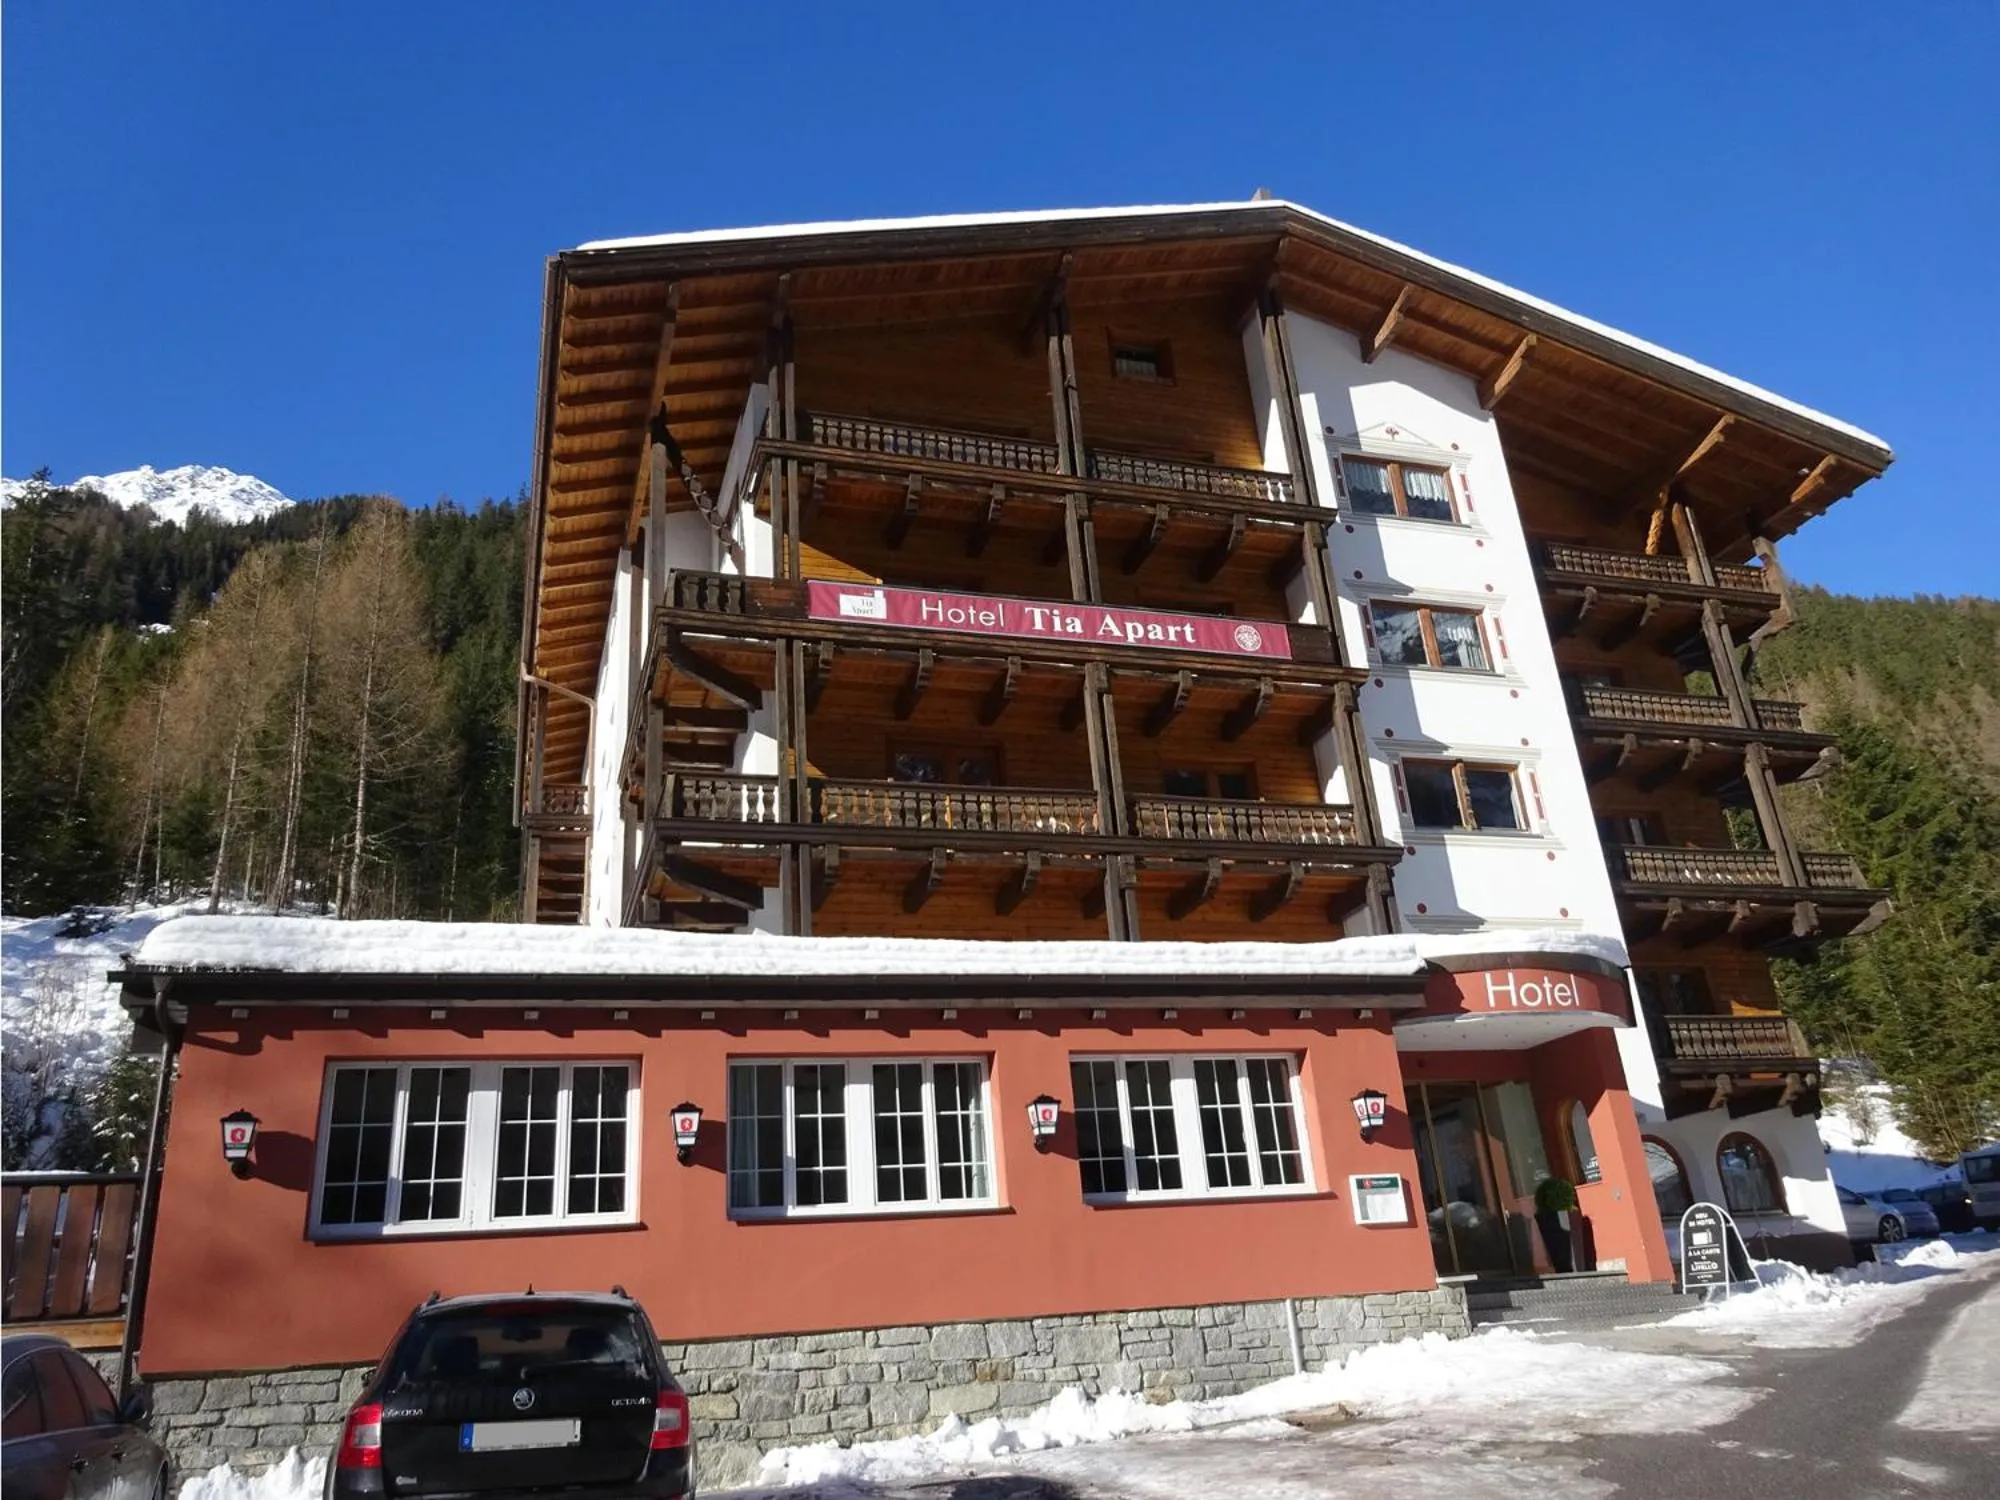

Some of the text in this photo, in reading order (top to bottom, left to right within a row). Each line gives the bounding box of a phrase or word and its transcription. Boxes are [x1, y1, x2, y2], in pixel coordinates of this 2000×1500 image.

[921, 598, 1196, 643] Hotel Tia Apart
[1485, 971, 1580, 1008] Hotel
